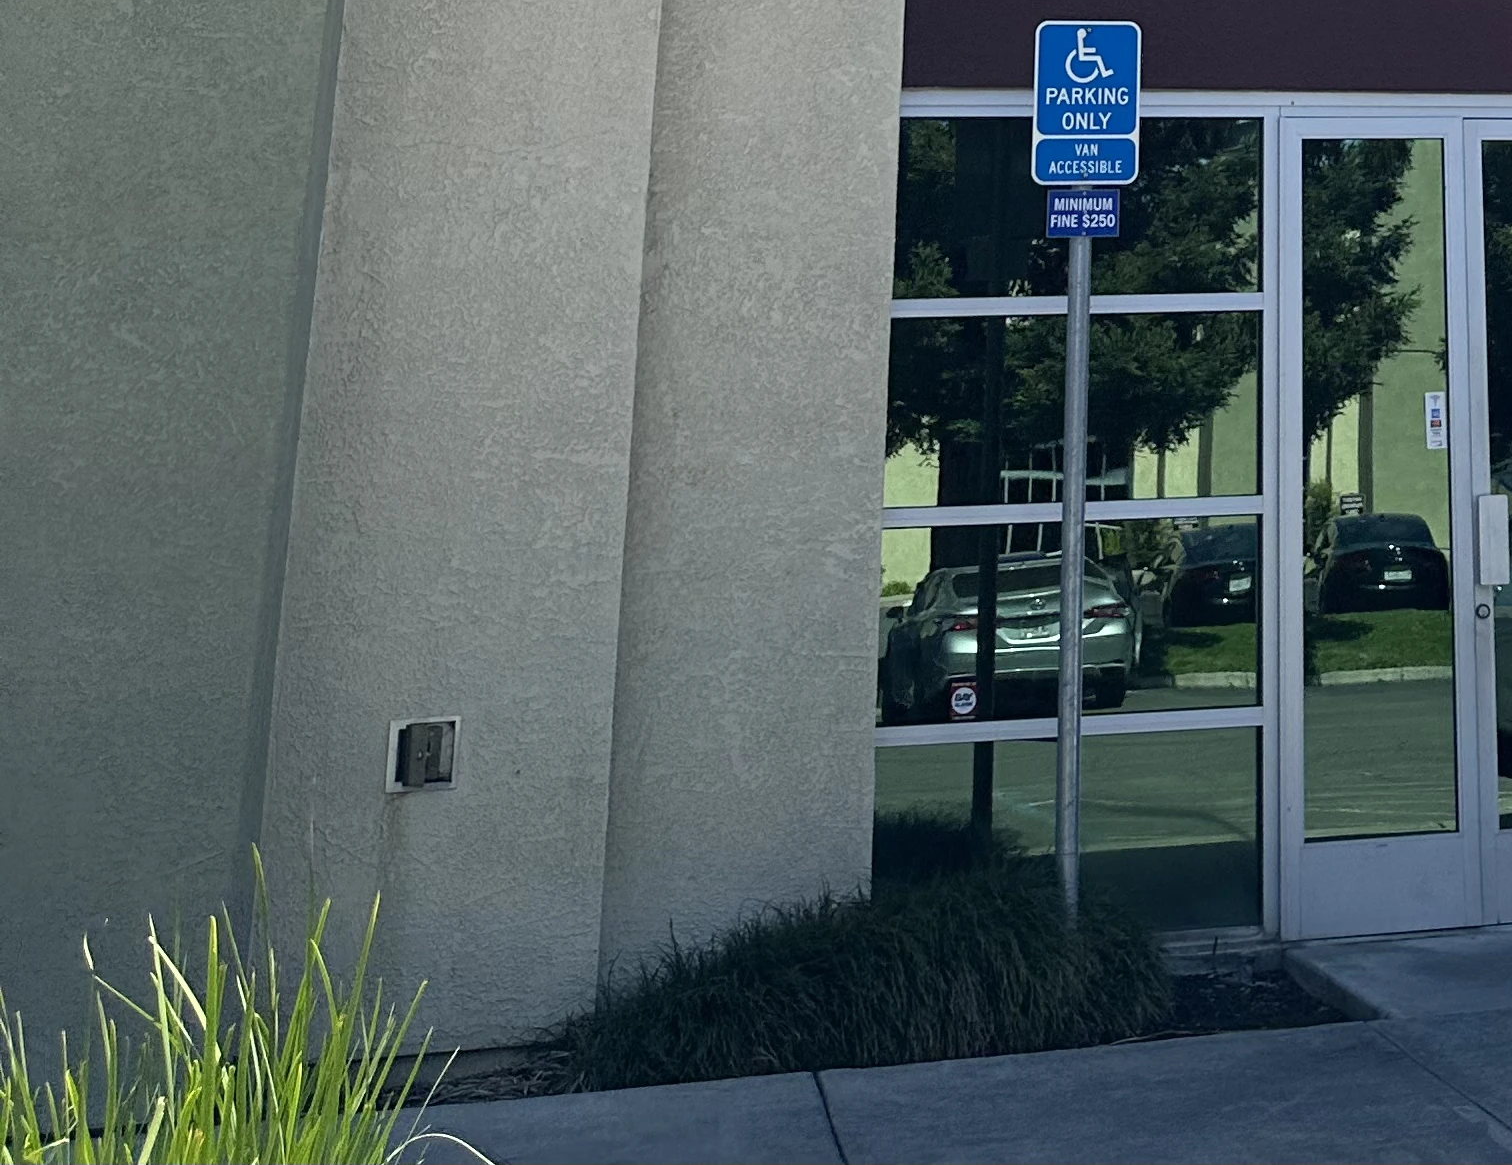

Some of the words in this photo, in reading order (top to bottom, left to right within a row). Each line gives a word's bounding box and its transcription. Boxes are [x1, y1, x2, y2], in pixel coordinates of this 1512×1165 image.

[1045, 87, 1129, 105] PARKING
[1062, 112, 1112, 130] ONLY
[1075, 144, 1098, 157] VAN
[1049, 160, 1122, 174] ACCESSIBLE
[1054, 197, 1113, 211] MINIMUM
[1050, 214, 1078, 228] FINE
[1082, 214, 1115, 229] $250
